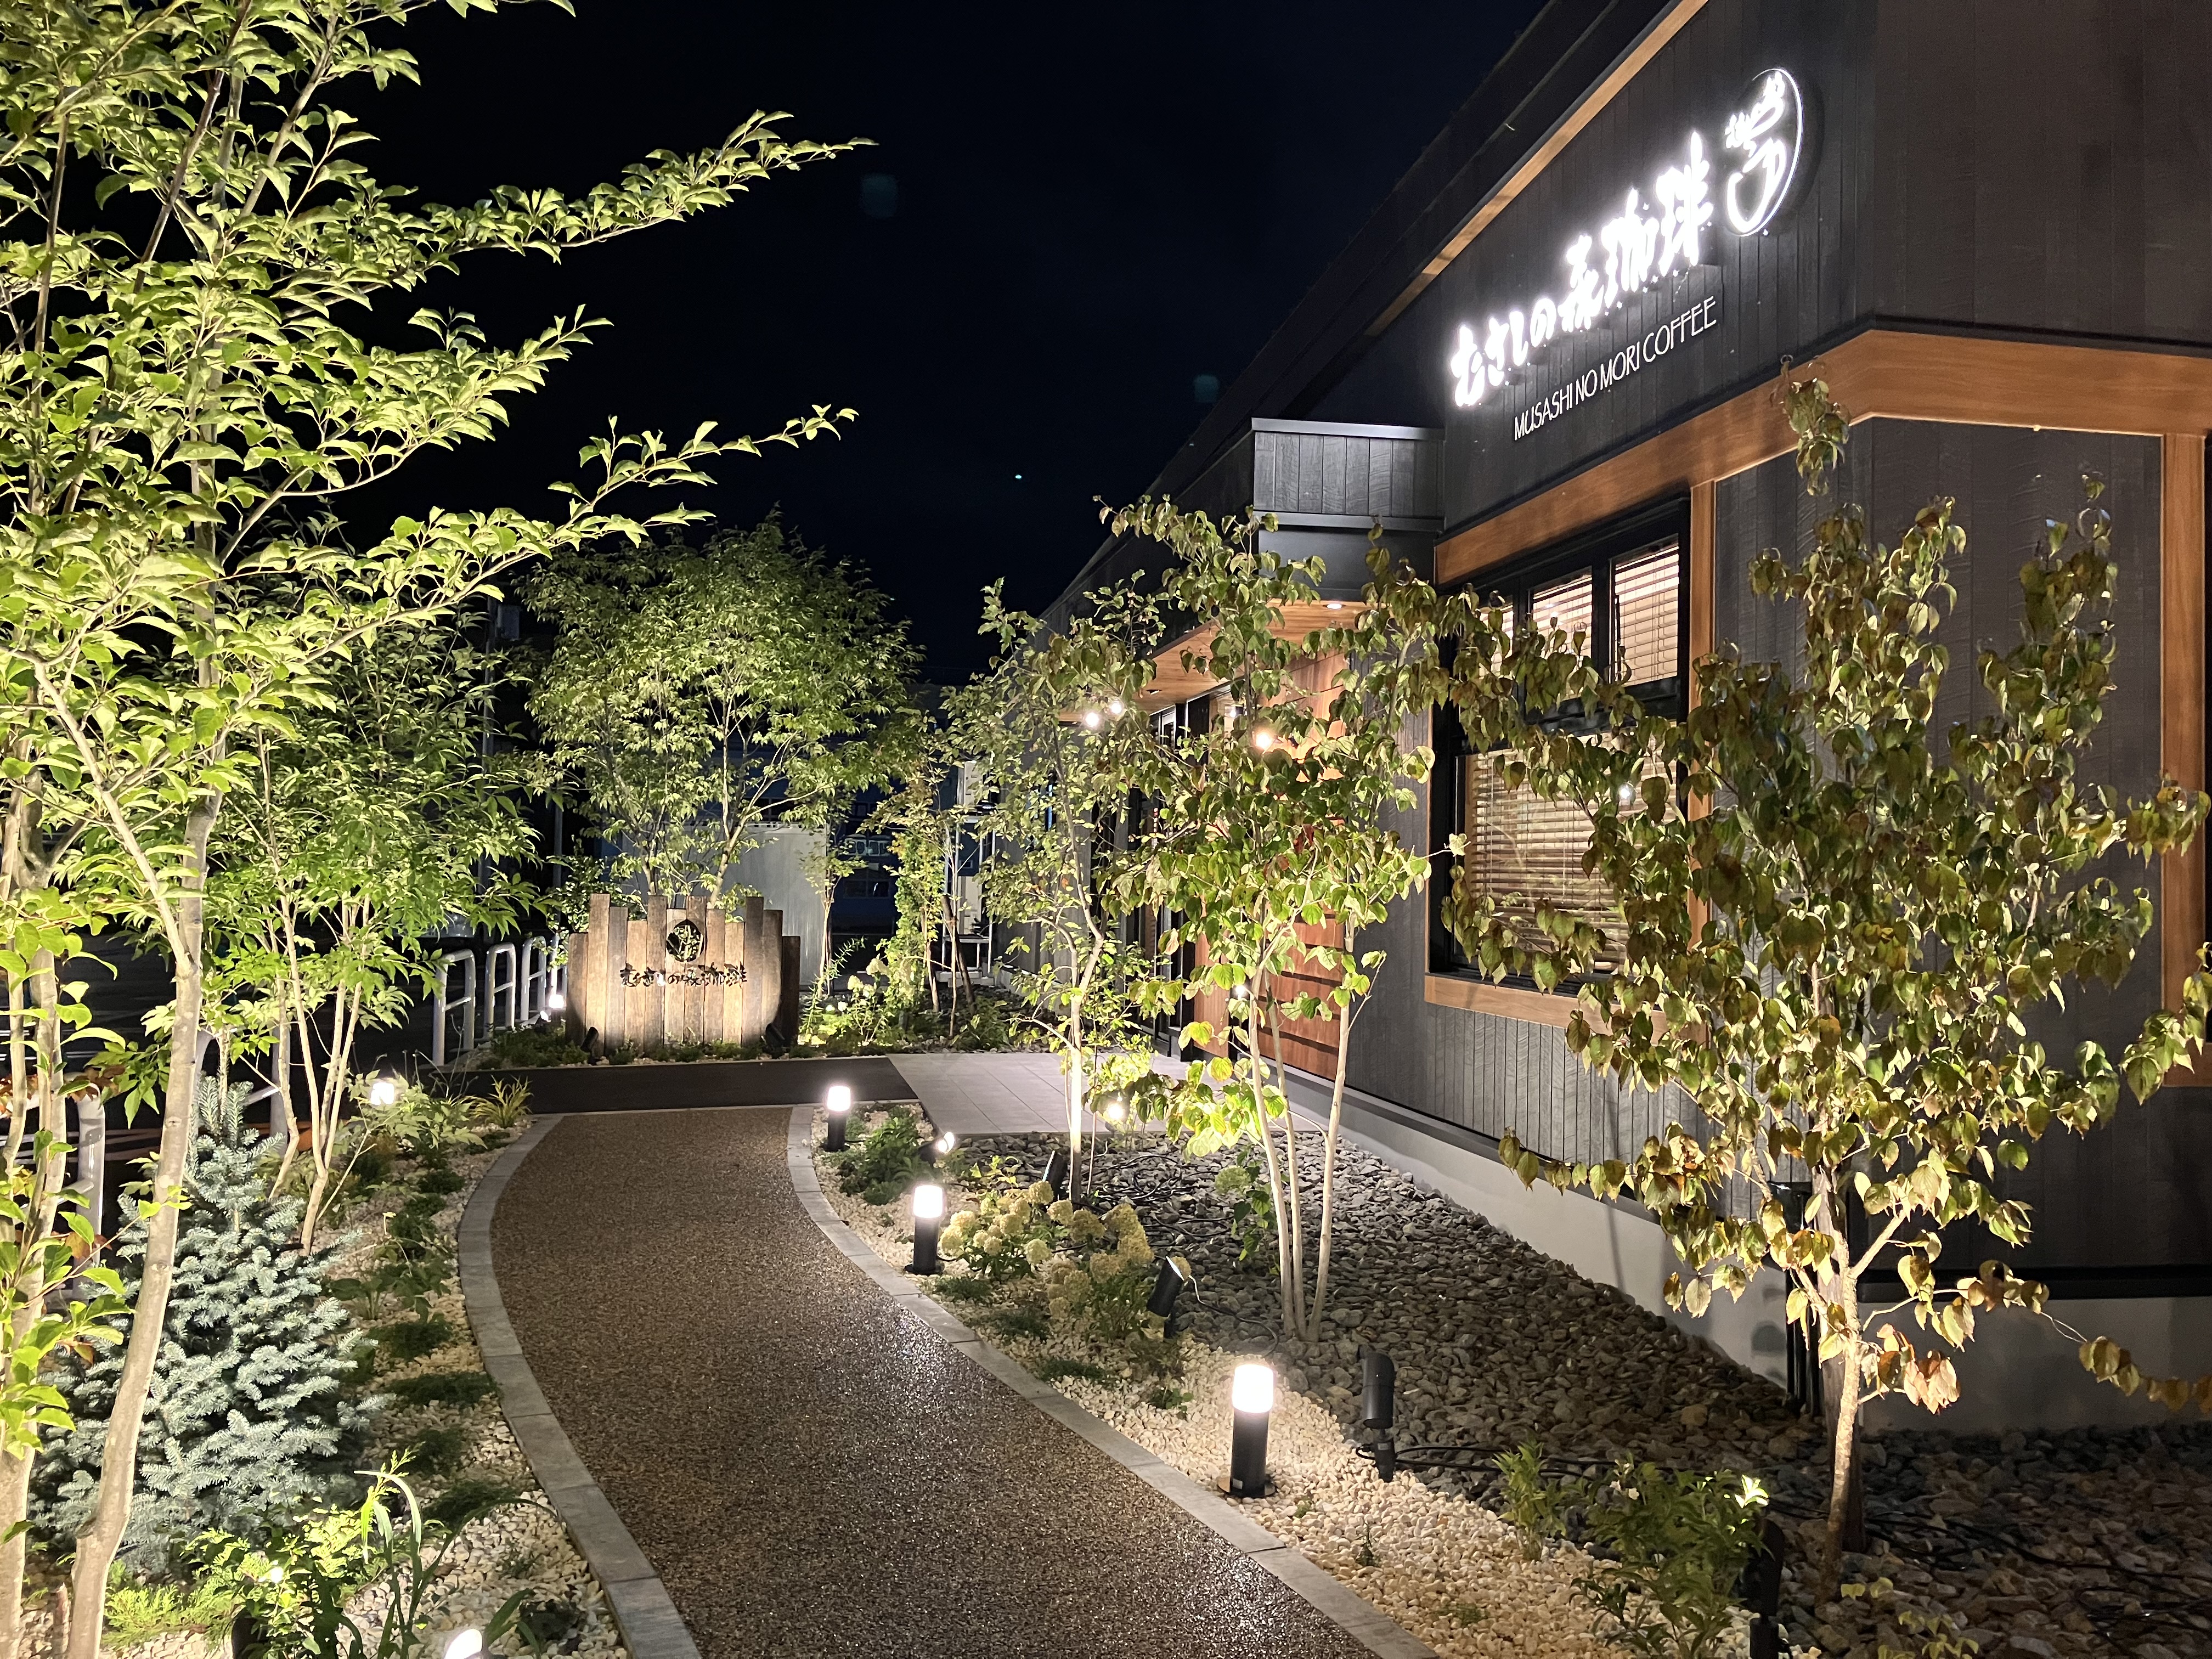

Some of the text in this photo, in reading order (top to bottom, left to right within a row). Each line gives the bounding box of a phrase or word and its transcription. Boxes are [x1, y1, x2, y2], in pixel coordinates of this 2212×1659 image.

[1514, 295, 1717, 441] MUSASHI NO MORI COFFEE
